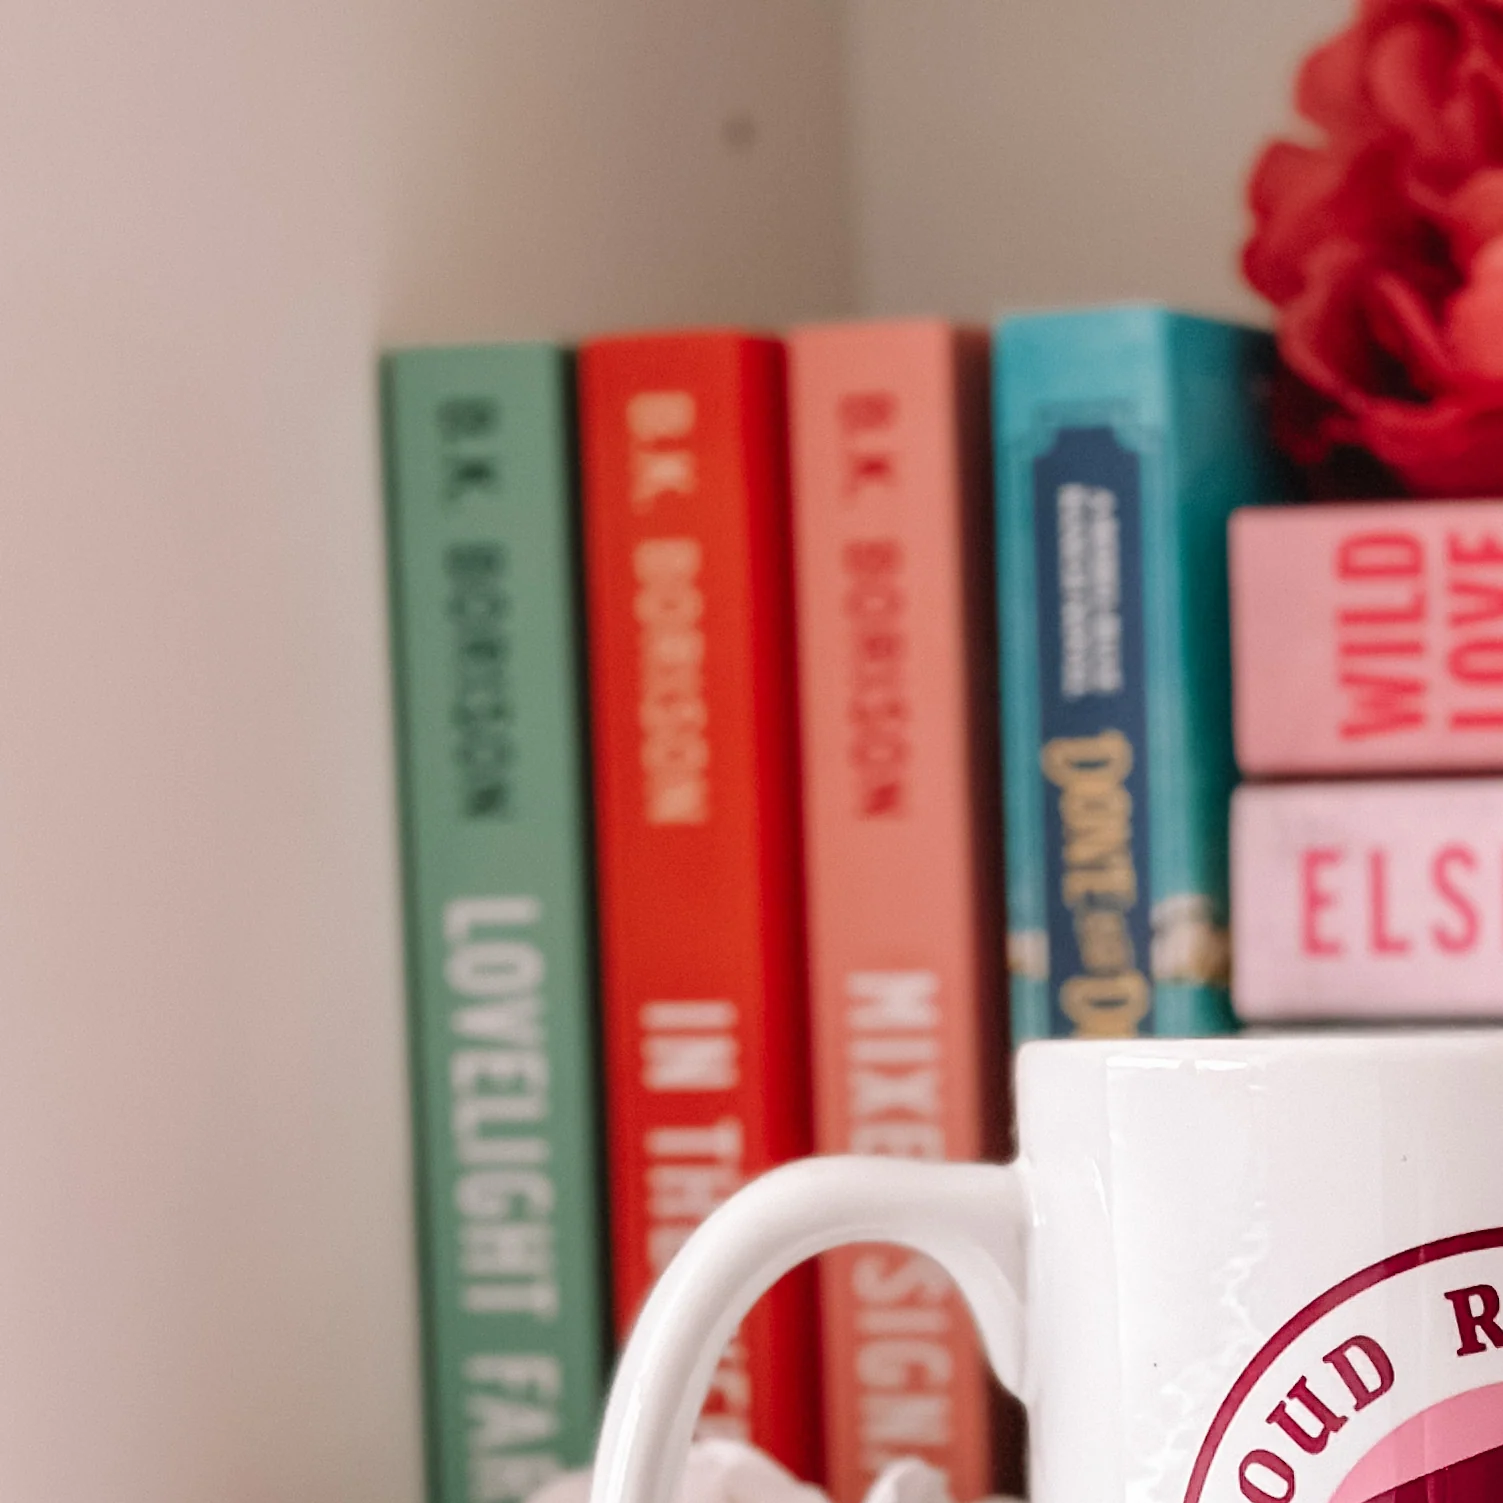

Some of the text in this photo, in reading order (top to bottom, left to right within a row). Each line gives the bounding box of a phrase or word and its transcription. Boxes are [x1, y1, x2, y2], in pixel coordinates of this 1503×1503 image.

[632, 537, 710, 826] BORISON
[840, 538, 914, 821] BORISON
[1334, 530, 1428, 743] WILD
[444, 896, 561, 1322] LOVELIGHT
[640, 1000, 740, 1093] IN
